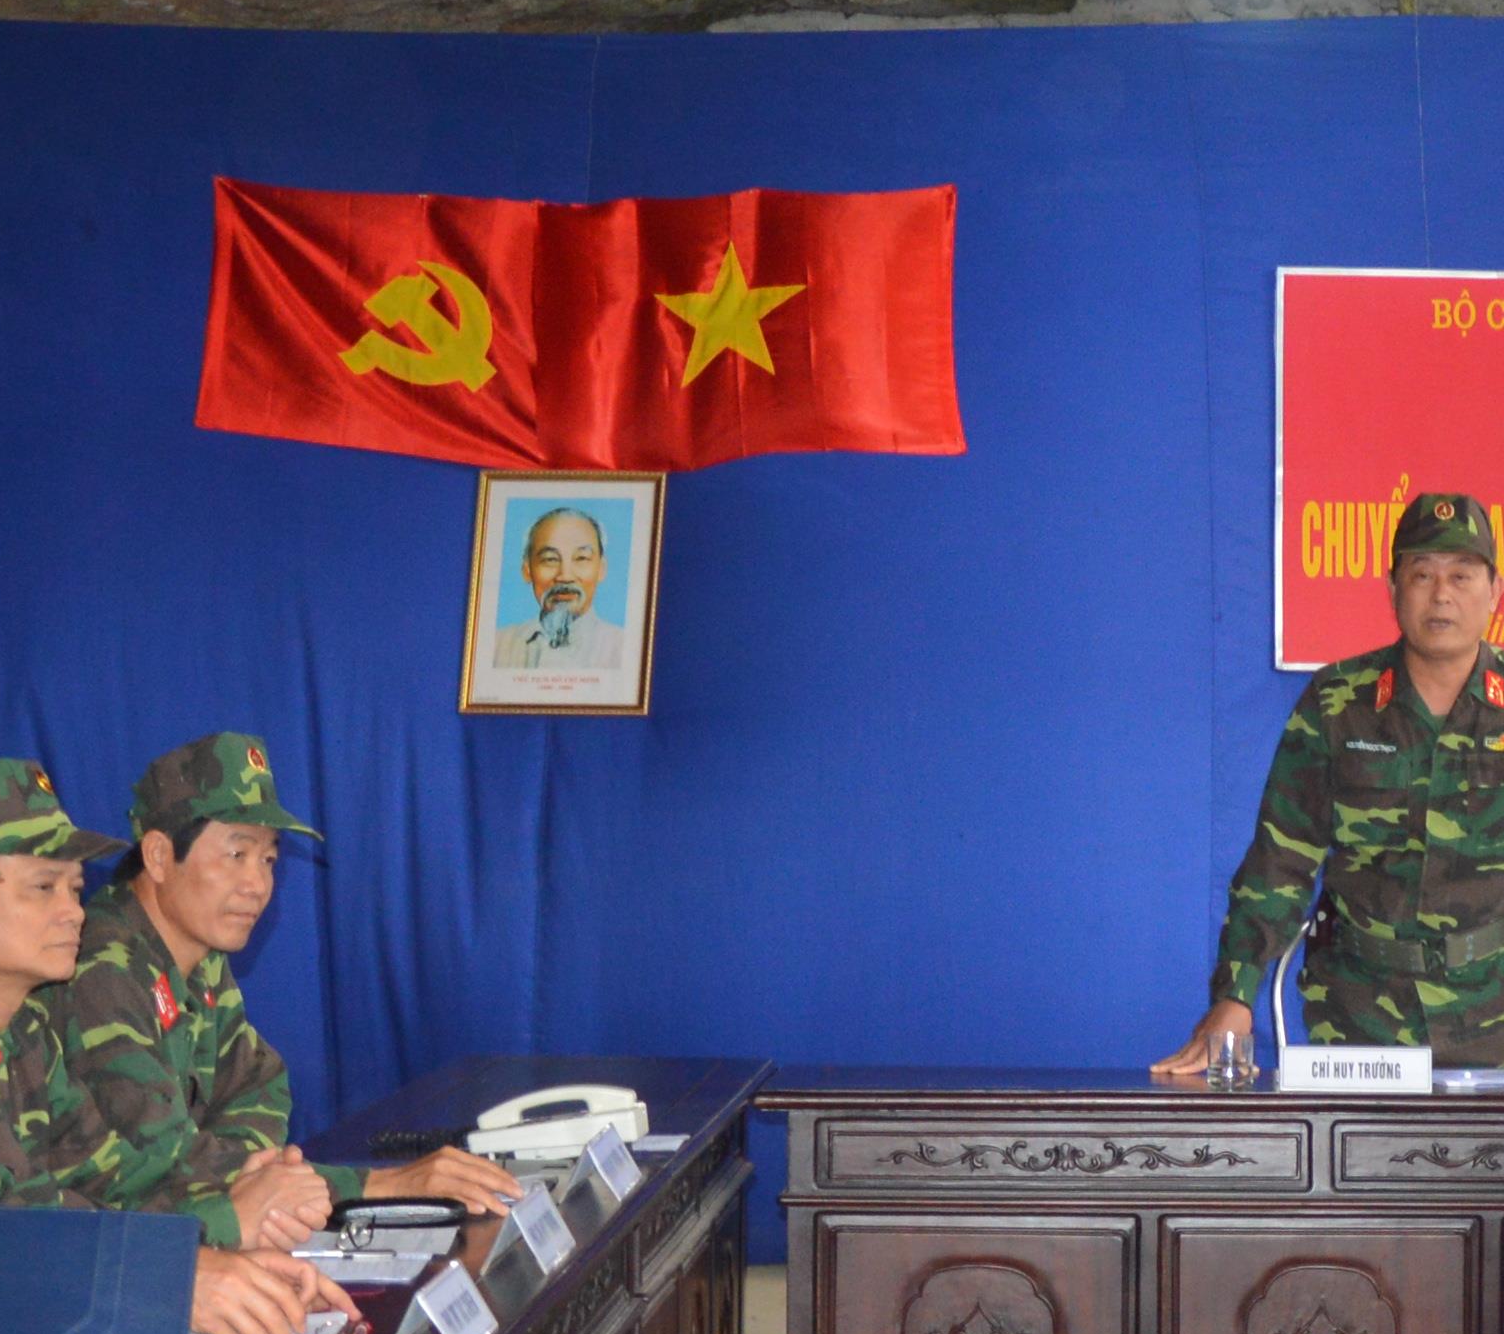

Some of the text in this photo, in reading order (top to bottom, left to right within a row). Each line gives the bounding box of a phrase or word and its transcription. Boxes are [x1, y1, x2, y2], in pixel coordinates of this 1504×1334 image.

[1431, 294, 1477, 337] BỘ
[1302, 473, 1410, 579] CHUYỂ
[1311, 1055, 1401, 1080] CHỈ HUY TRƯỞNG
